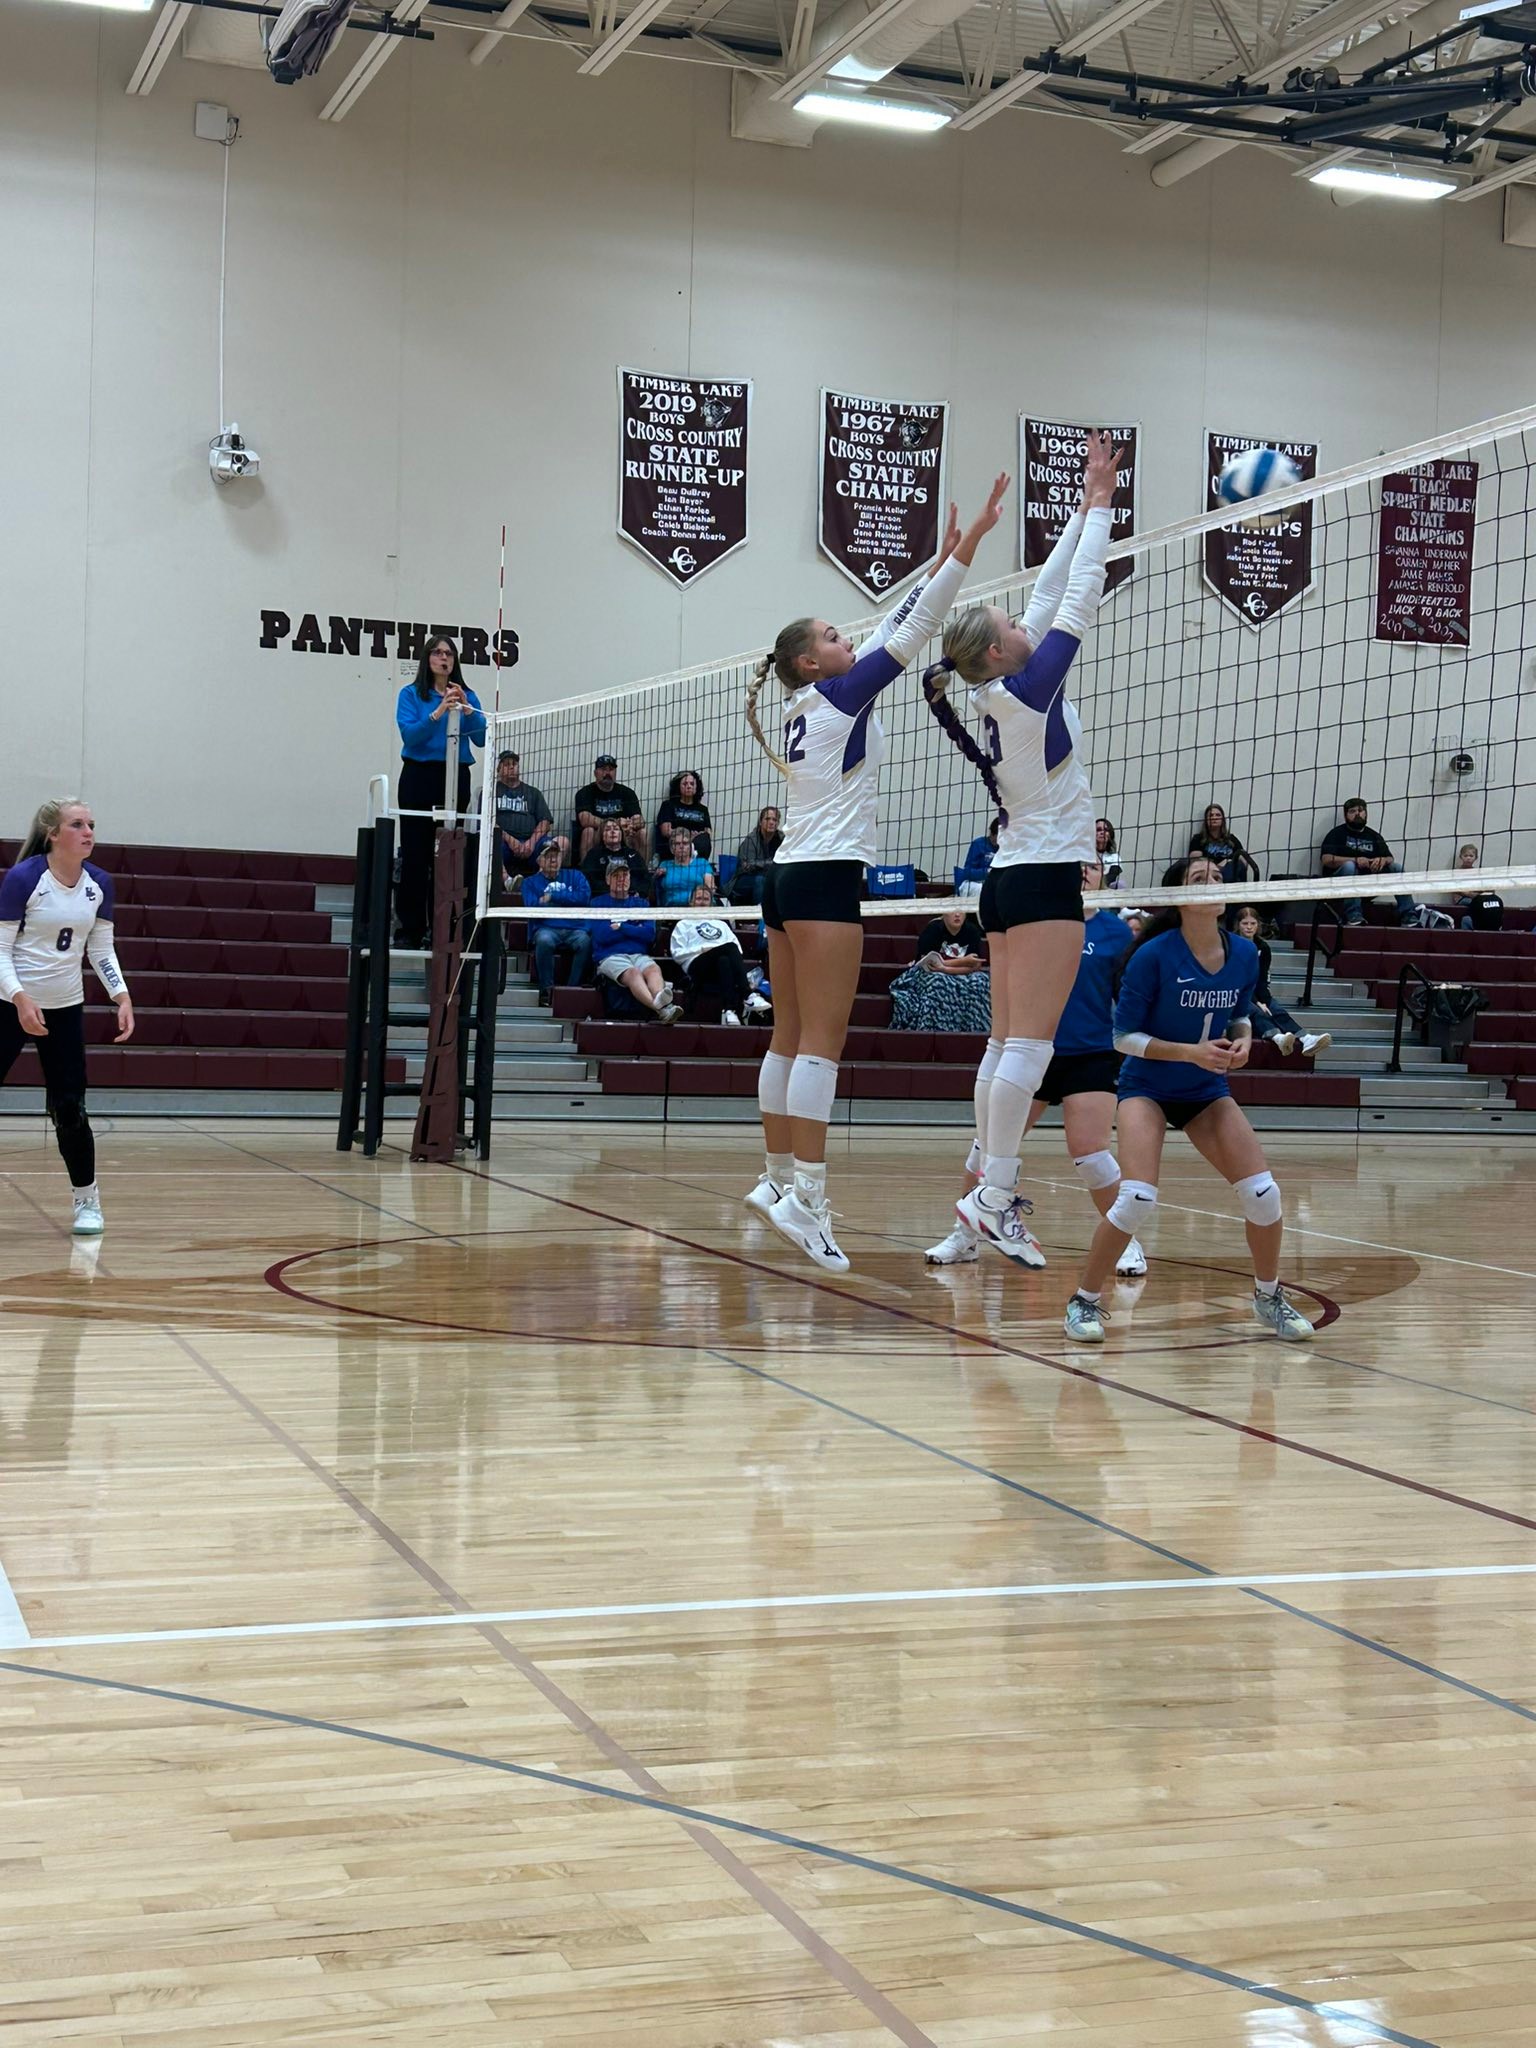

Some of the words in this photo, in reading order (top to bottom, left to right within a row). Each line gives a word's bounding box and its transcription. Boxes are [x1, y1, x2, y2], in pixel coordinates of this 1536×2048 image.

[628, 374, 692, 393] TIMBER
[699, 383, 743, 398] LAKE
[639, 391, 697, 413] 2019
[831, 394, 892, 414] TIMBER
[899, 404, 940, 419] LAKE
[649, 411, 686, 426] BOYS
[840, 411, 896, 433] 1967
[626, 417, 674, 443] CROSS
[678, 426, 743, 448] COUNTRY
[850, 431, 884, 445] BOYS
[1030, 421, 1087, 439] TIMBER
[649, 444, 720, 467] STATE
[829, 436, 873, 462] CROSS
[877, 446, 940, 468] COUNTRY
[1039, 437, 1089, 457] 1966
[1213, 435, 1268, 451] TIMBER
[1275, 443, 1313, 457] LAKE
[625, 459, 745, 486] RUNNER-UP
[848, 462, 917, 485] STATE
[1029, 461, 1071, 485] CROSS
[1048, 456, 1081, 469] BOYS
[1441, 464, 1473, 481] LAKE
[835, 479, 928, 504] CHAMPS
[1047, 485, 1086, 504] STA
[1409, 477, 1451, 496] TRACK
[658, 503, 682, 513] Ethan
[1026, 501, 1132, 525] RUNNUP
[1381, 490, 1427, 510] SPRINT
[1430, 495, 1476, 514] MEDLEY
[1409, 510, 1447, 528] STATE
[1394, 525, 1465, 546] CHAMPIONS
[847, 545, 872, 555] Coach
[1395, 557, 1428, 569] CARMEN
[1388, 604, 1416, 615] BACK
[1421, 606, 1433, 617] TO
[1435, 608, 1464, 618] BACK
[1395, 594, 1457, 607] UNDEFEATED
[1380, 613, 1406, 640] 2001
[1428, 616, 1454, 643] 2002
[56, 927, 74, 952] 8
[1180, 988, 1240, 1009] COWGIRLS
[1199, 1012, 1214, 1045] 1
